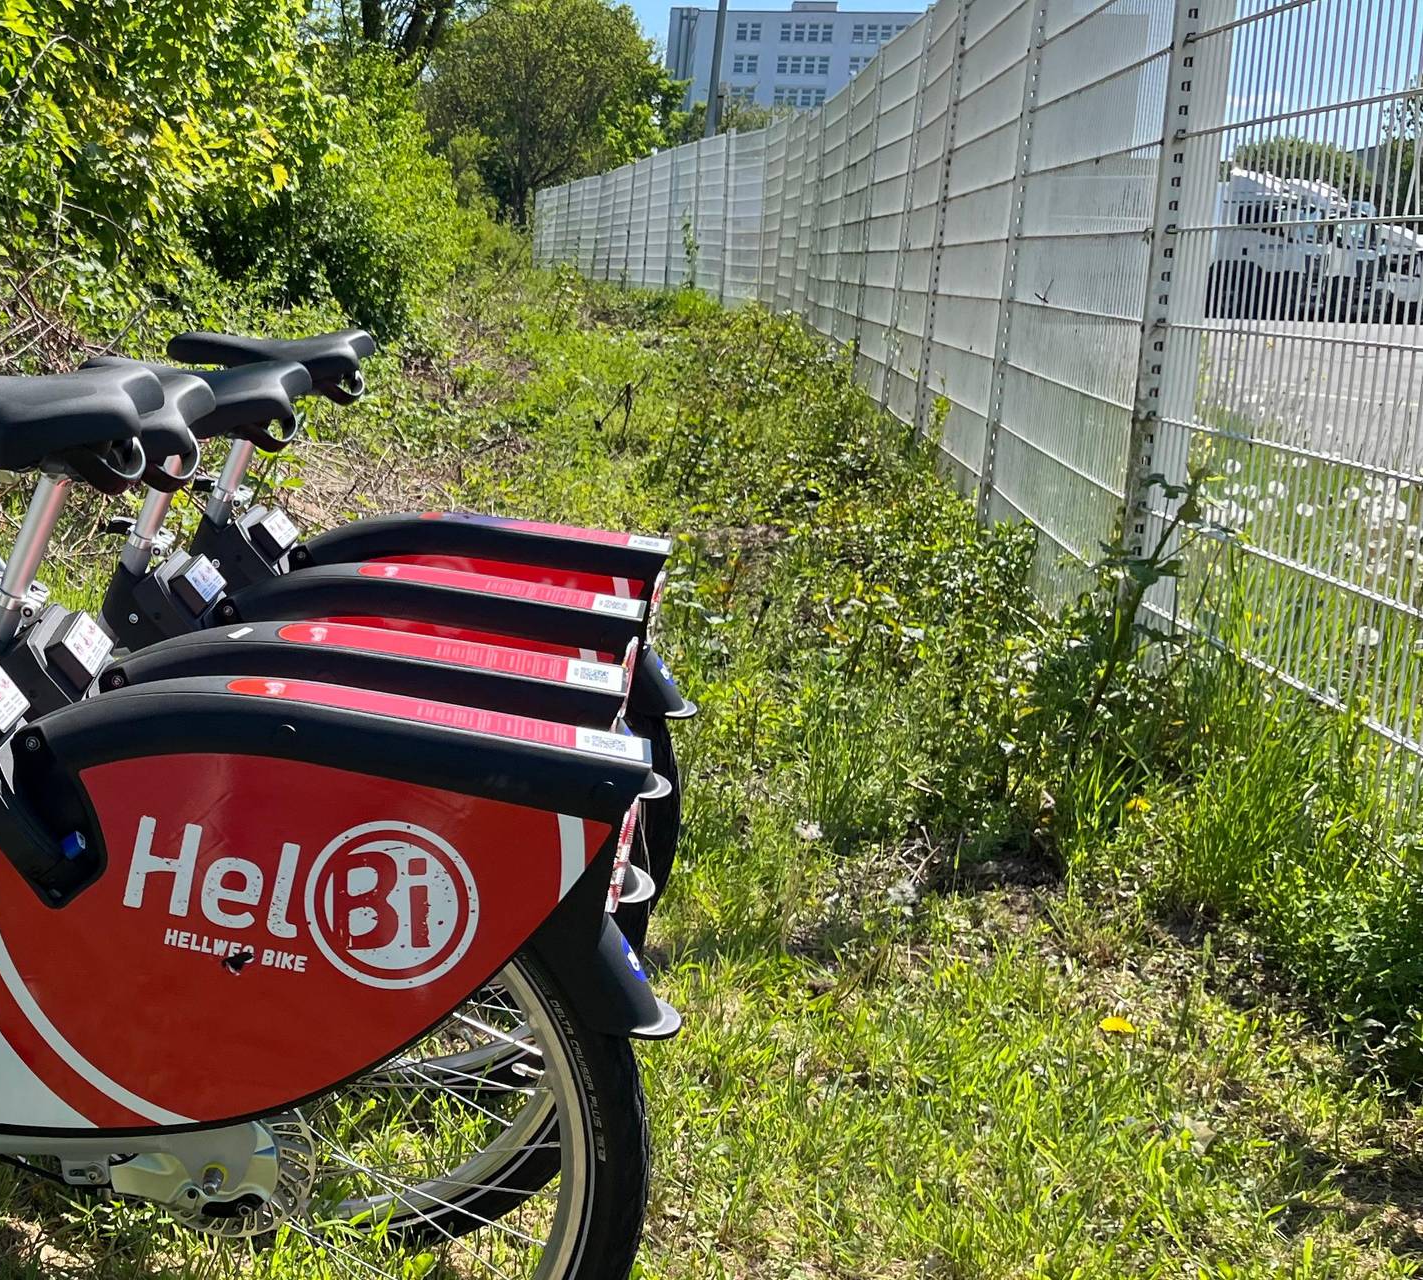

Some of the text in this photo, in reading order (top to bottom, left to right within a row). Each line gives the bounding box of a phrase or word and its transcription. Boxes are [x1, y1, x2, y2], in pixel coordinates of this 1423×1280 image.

[261, 949, 308, 973] BIKE
[550, 1000, 574, 1036] DELTA
[571, 1040, 594, 1092] CRUISER
[590, 1096, 603, 1129] PLUS
